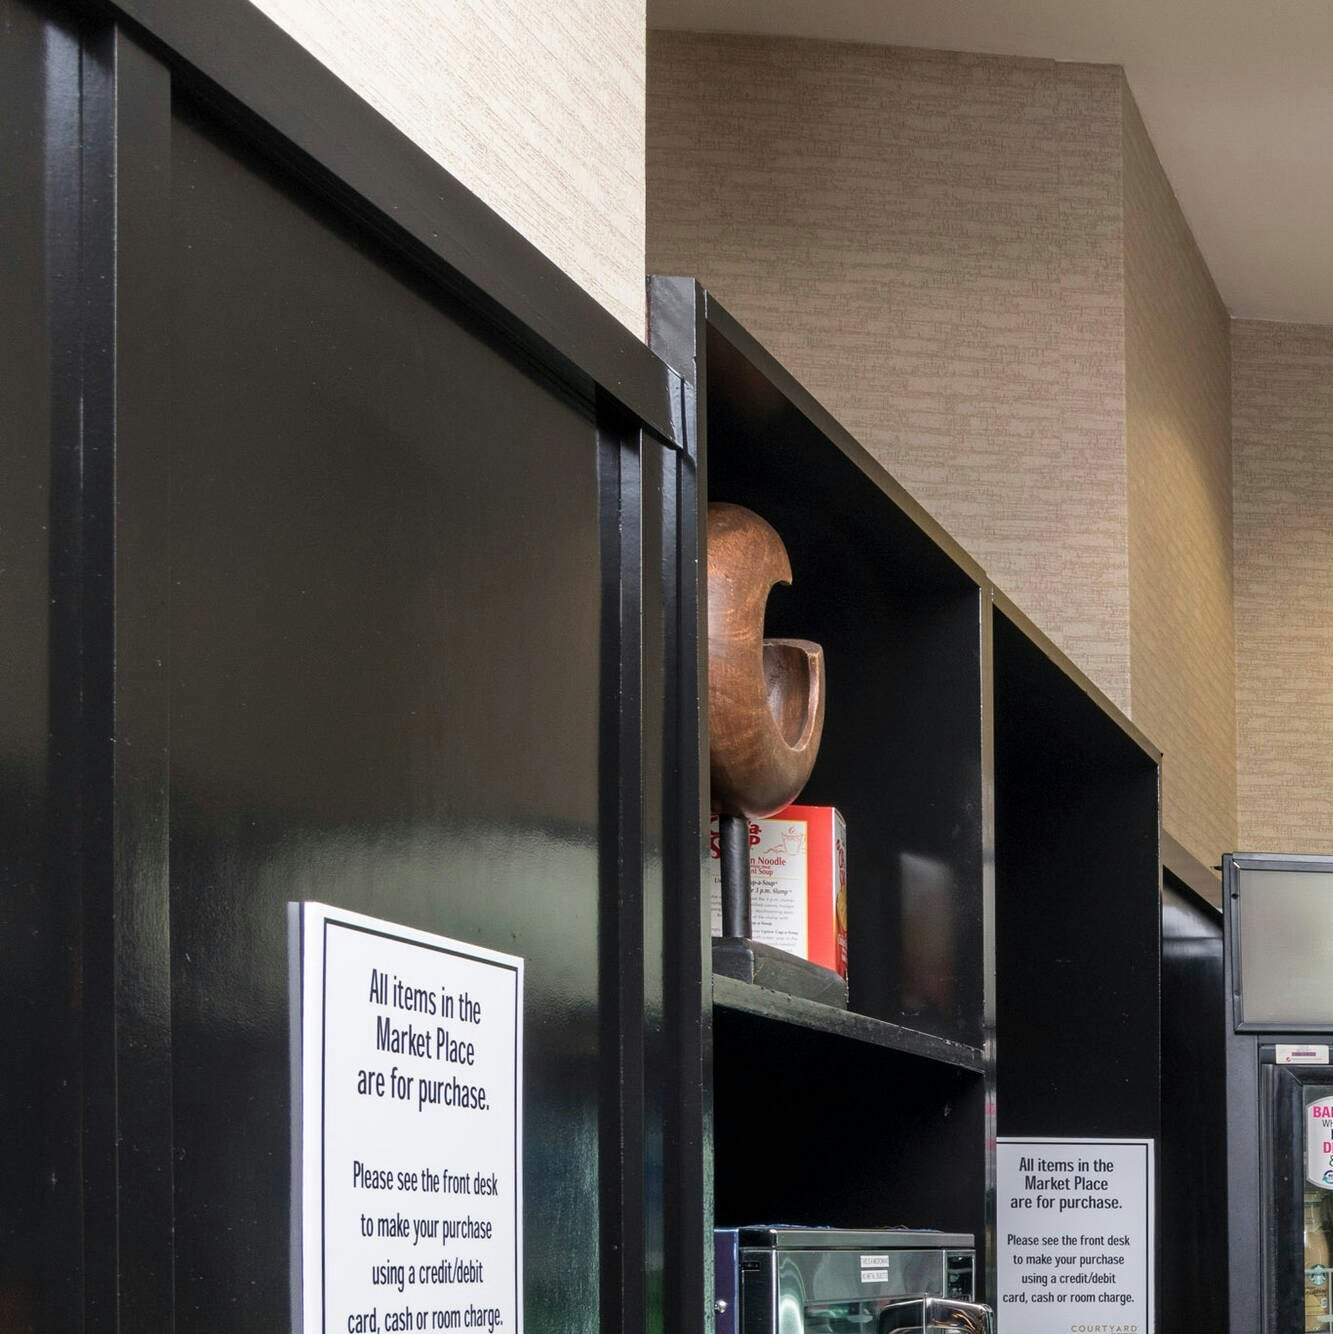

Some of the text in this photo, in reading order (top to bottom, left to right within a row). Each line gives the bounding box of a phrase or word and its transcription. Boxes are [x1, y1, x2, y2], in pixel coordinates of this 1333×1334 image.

[758, 857, 787, 866] Noodle
[759, 868, 774, 876] Soup
[369, 968, 481, 1025] All items in the
[376, 1015, 475, 1066] Market Place
[357, 1066, 490, 1112] are for purchase.
[1019, 1156, 1114, 1172] All items in the
[353, 1160, 499, 1196] Please see the front desk
[1024, 1175, 1109, 1191] Market Place
[1010, 1194, 1123, 1212] are for purchase.
[361, 1212, 493, 1246] to make your purchase
[1007, 1233, 1130, 1246] Please see the front desk
[1013, 1253, 1125, 1268] to make your purchase
[372, 1257, 484, 1293] using a credit/debit
[1021, 1271, 1116, 1287] using a credit/debit
[1002, 1291, 1135, 1306] card, cash or room charge.
[384, 1306, 413, 1332] cash
[416, 1311, 429, 1330] or
[432, 1308, 461, 1330] room
[464, 1304, 504, 1334] charge.
[1070, 1324, 1138, 1333] COURTYARD
